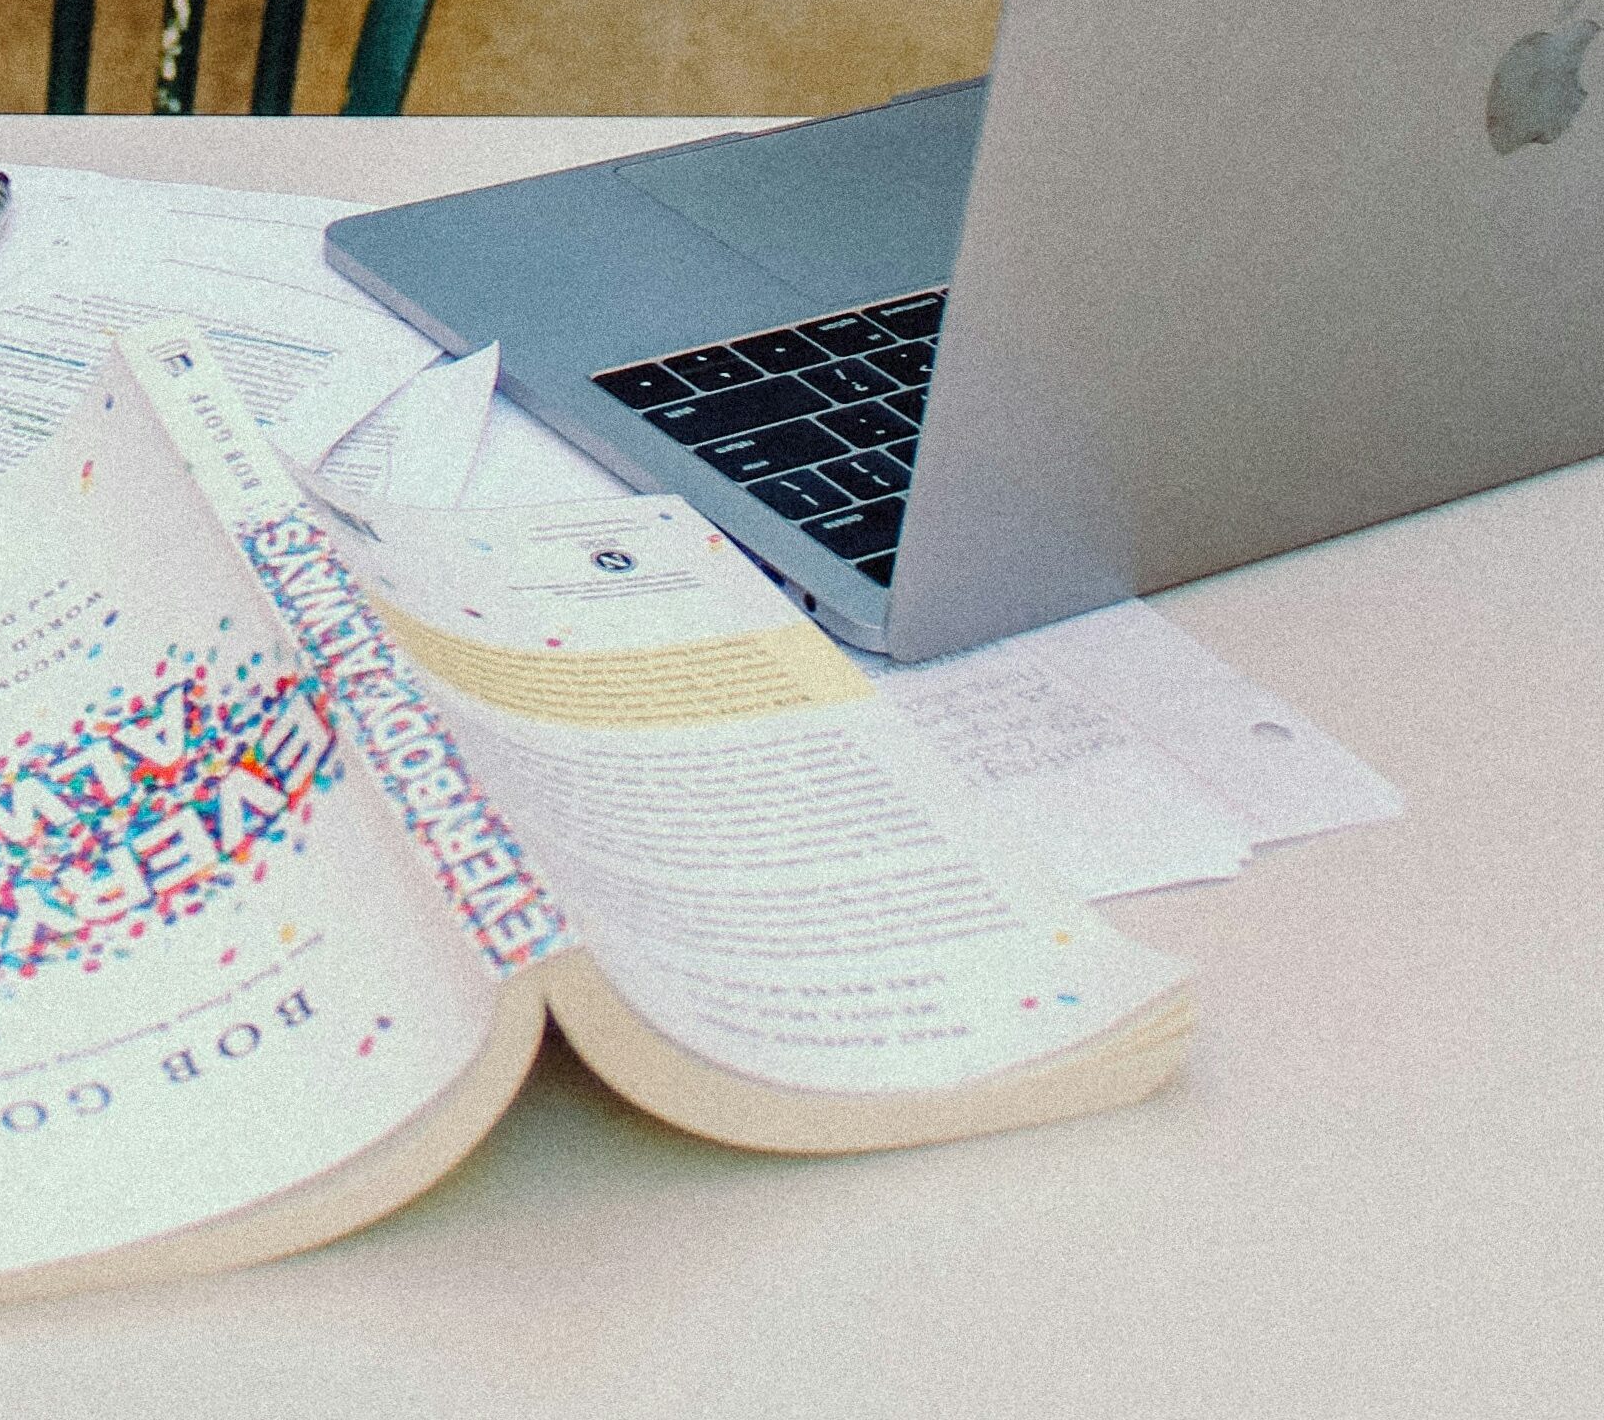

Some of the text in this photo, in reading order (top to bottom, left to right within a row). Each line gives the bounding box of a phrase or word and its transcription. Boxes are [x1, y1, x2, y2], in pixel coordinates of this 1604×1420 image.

[12, 592, 102, 653] WORLD
[255, 519, 392, 681] ALWAYS
[162, 986, 315, 1084] BOB
